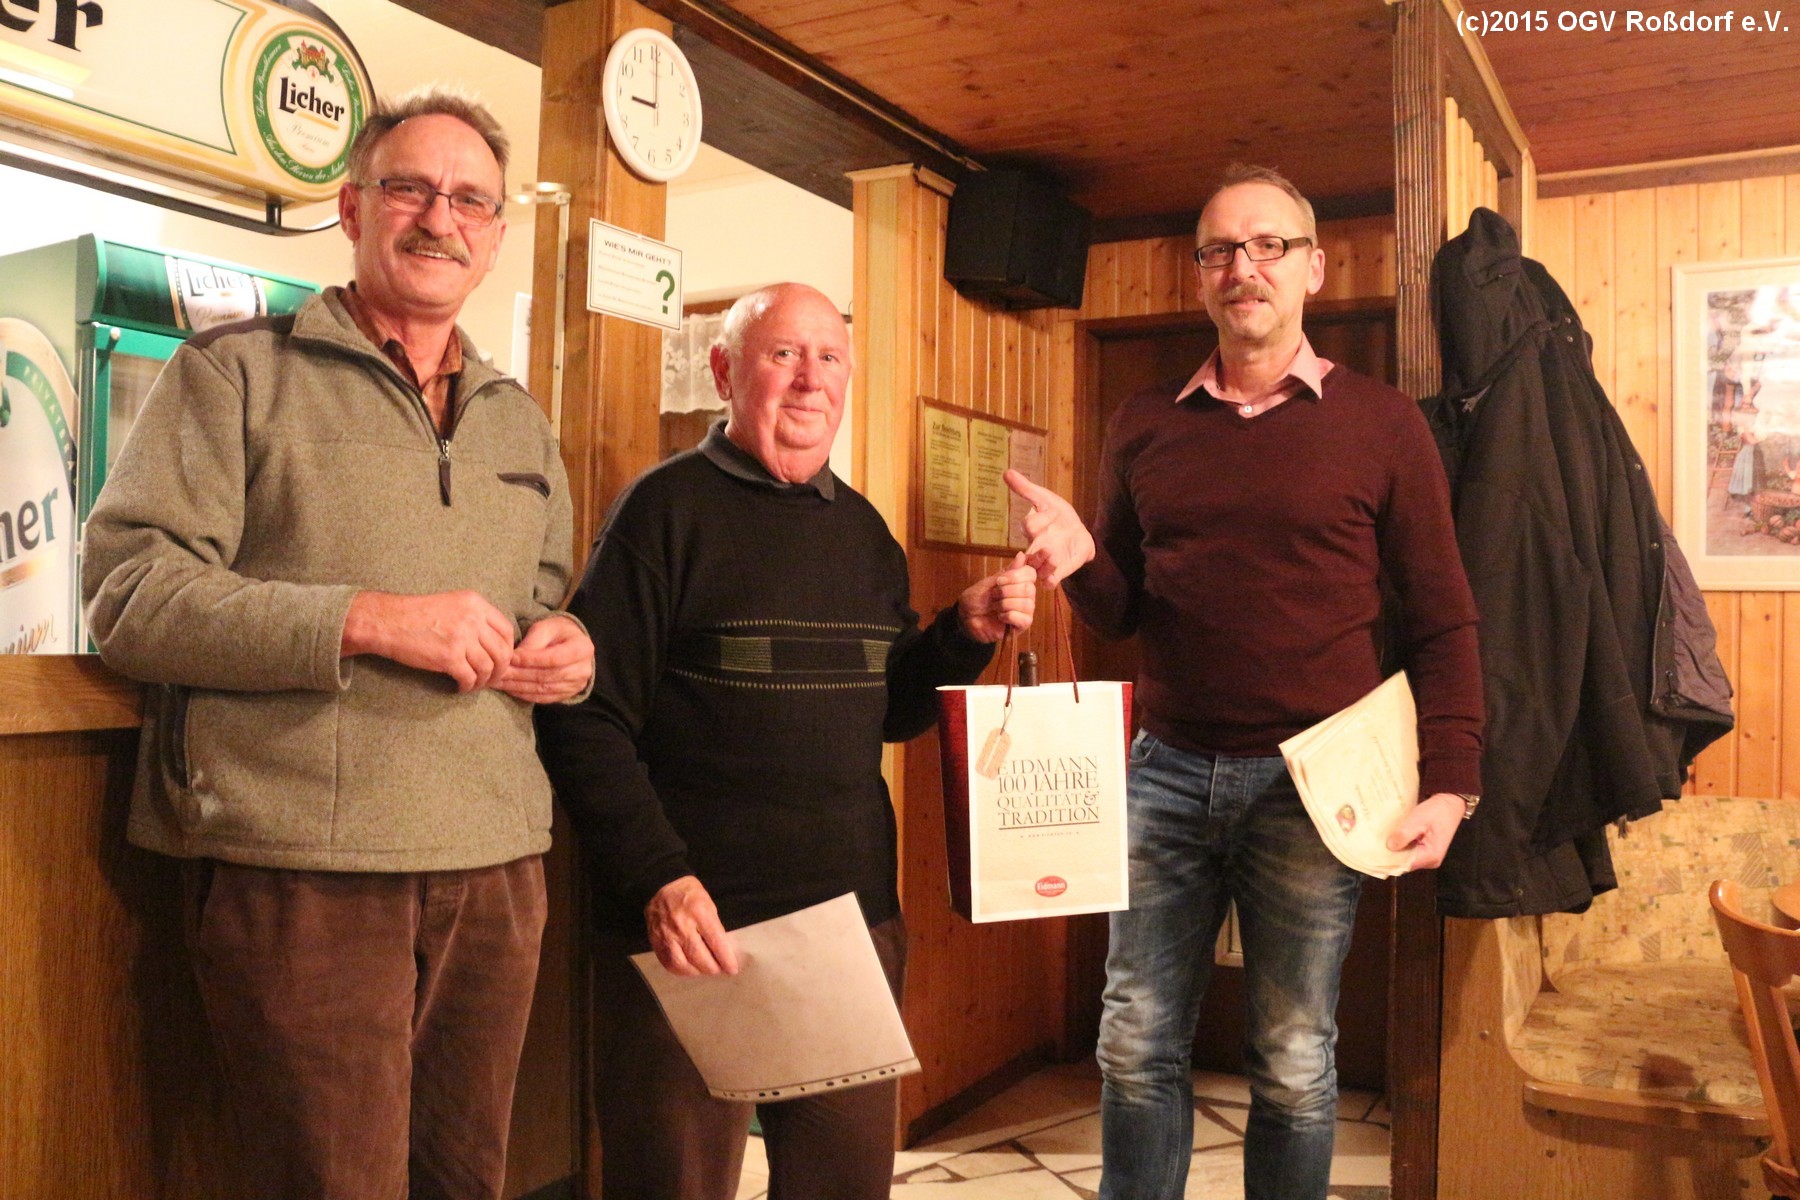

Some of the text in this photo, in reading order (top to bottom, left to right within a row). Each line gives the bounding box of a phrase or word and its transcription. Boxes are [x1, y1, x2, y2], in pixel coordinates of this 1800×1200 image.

[633, 46, 642, 63] 11
[651, 45, 661, 63] 12
[622, 61, 634, 78] 10
[670, 61, 674, 76] 1
[279, 76, 345, 122] Licher
[679, 84, 685, 98] 2
[683, 112, 690, 127] 3
[632, 135, 639, 150] 7
[676, 136, 682, 151] 4
[648, 149, 655, 164] 6
[665, 149, 672, 164] 5
[604, 239, 626, 253] WIE'S
[628, 247, 644, 258] MIR
[656, 269, 675, 315] ?
[998, 770, 1099, 795] 100 JAHRE
[1083, 790, 1100, 806] &
[997, 806, 1099, 826] TRADITION
[1037, 881, 1066, 891] Eidmann
